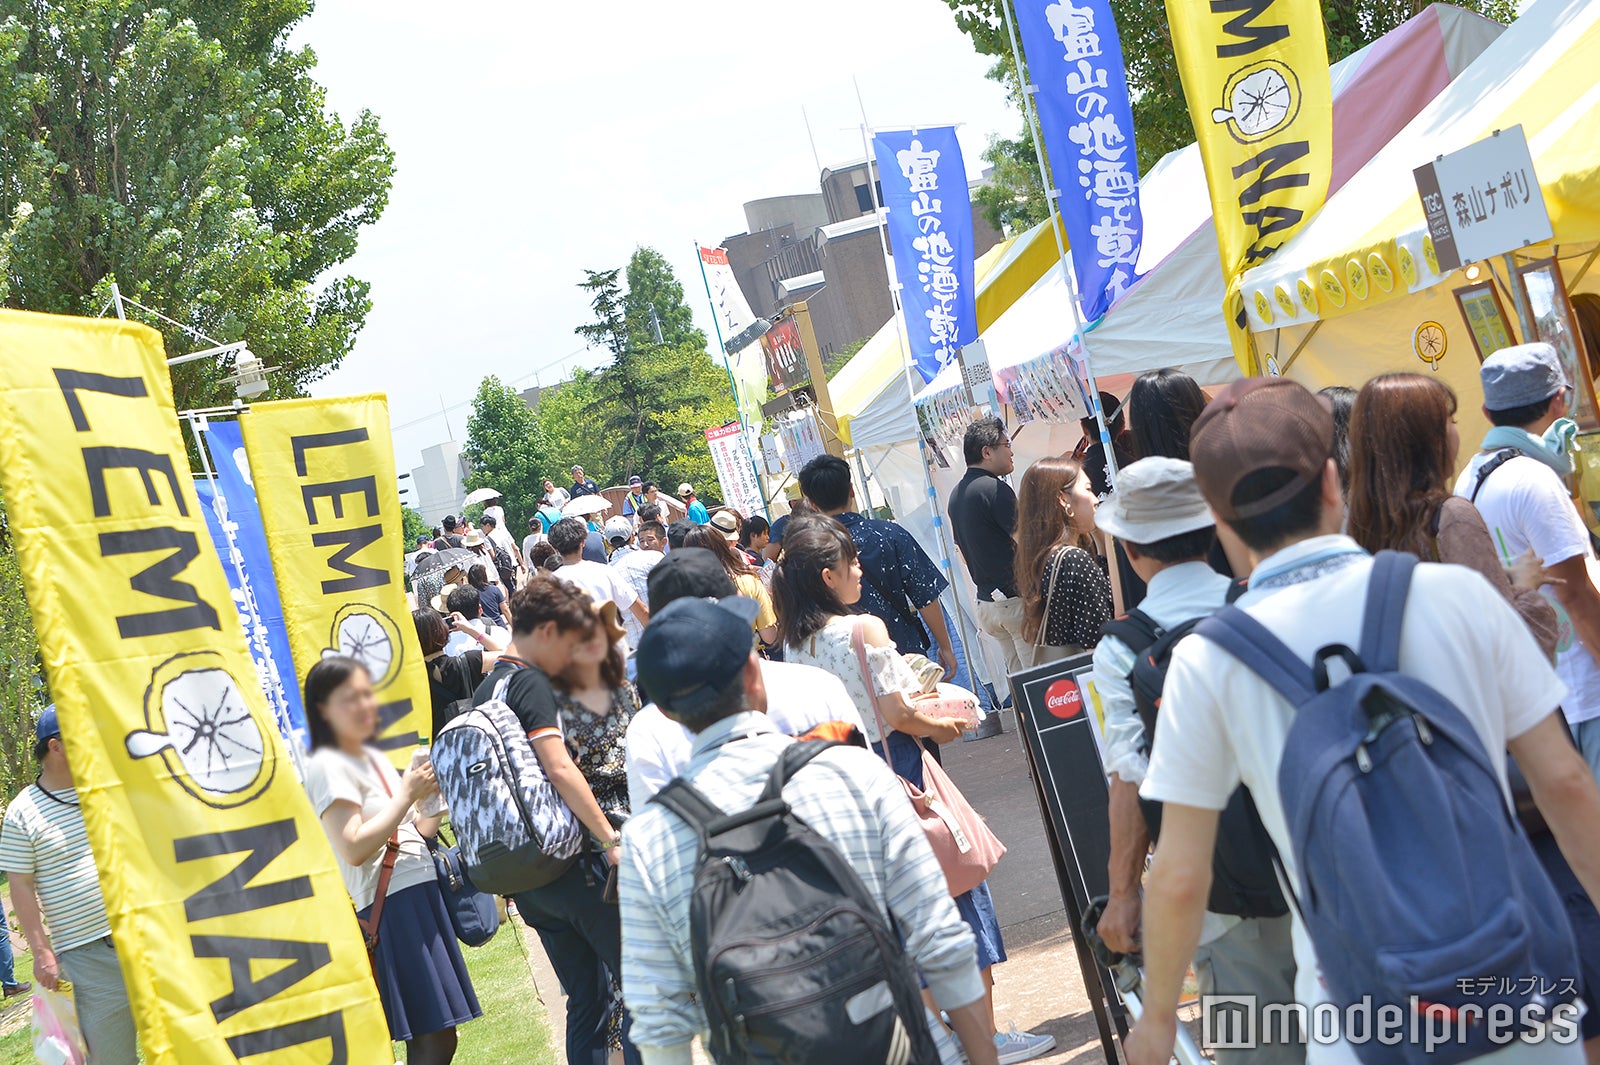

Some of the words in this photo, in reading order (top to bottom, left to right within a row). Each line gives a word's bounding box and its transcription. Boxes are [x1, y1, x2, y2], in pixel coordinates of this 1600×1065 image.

[1423, 191, 1442, 214] TGC
[1451, 168, 1530, 229] 森山ナポリ
